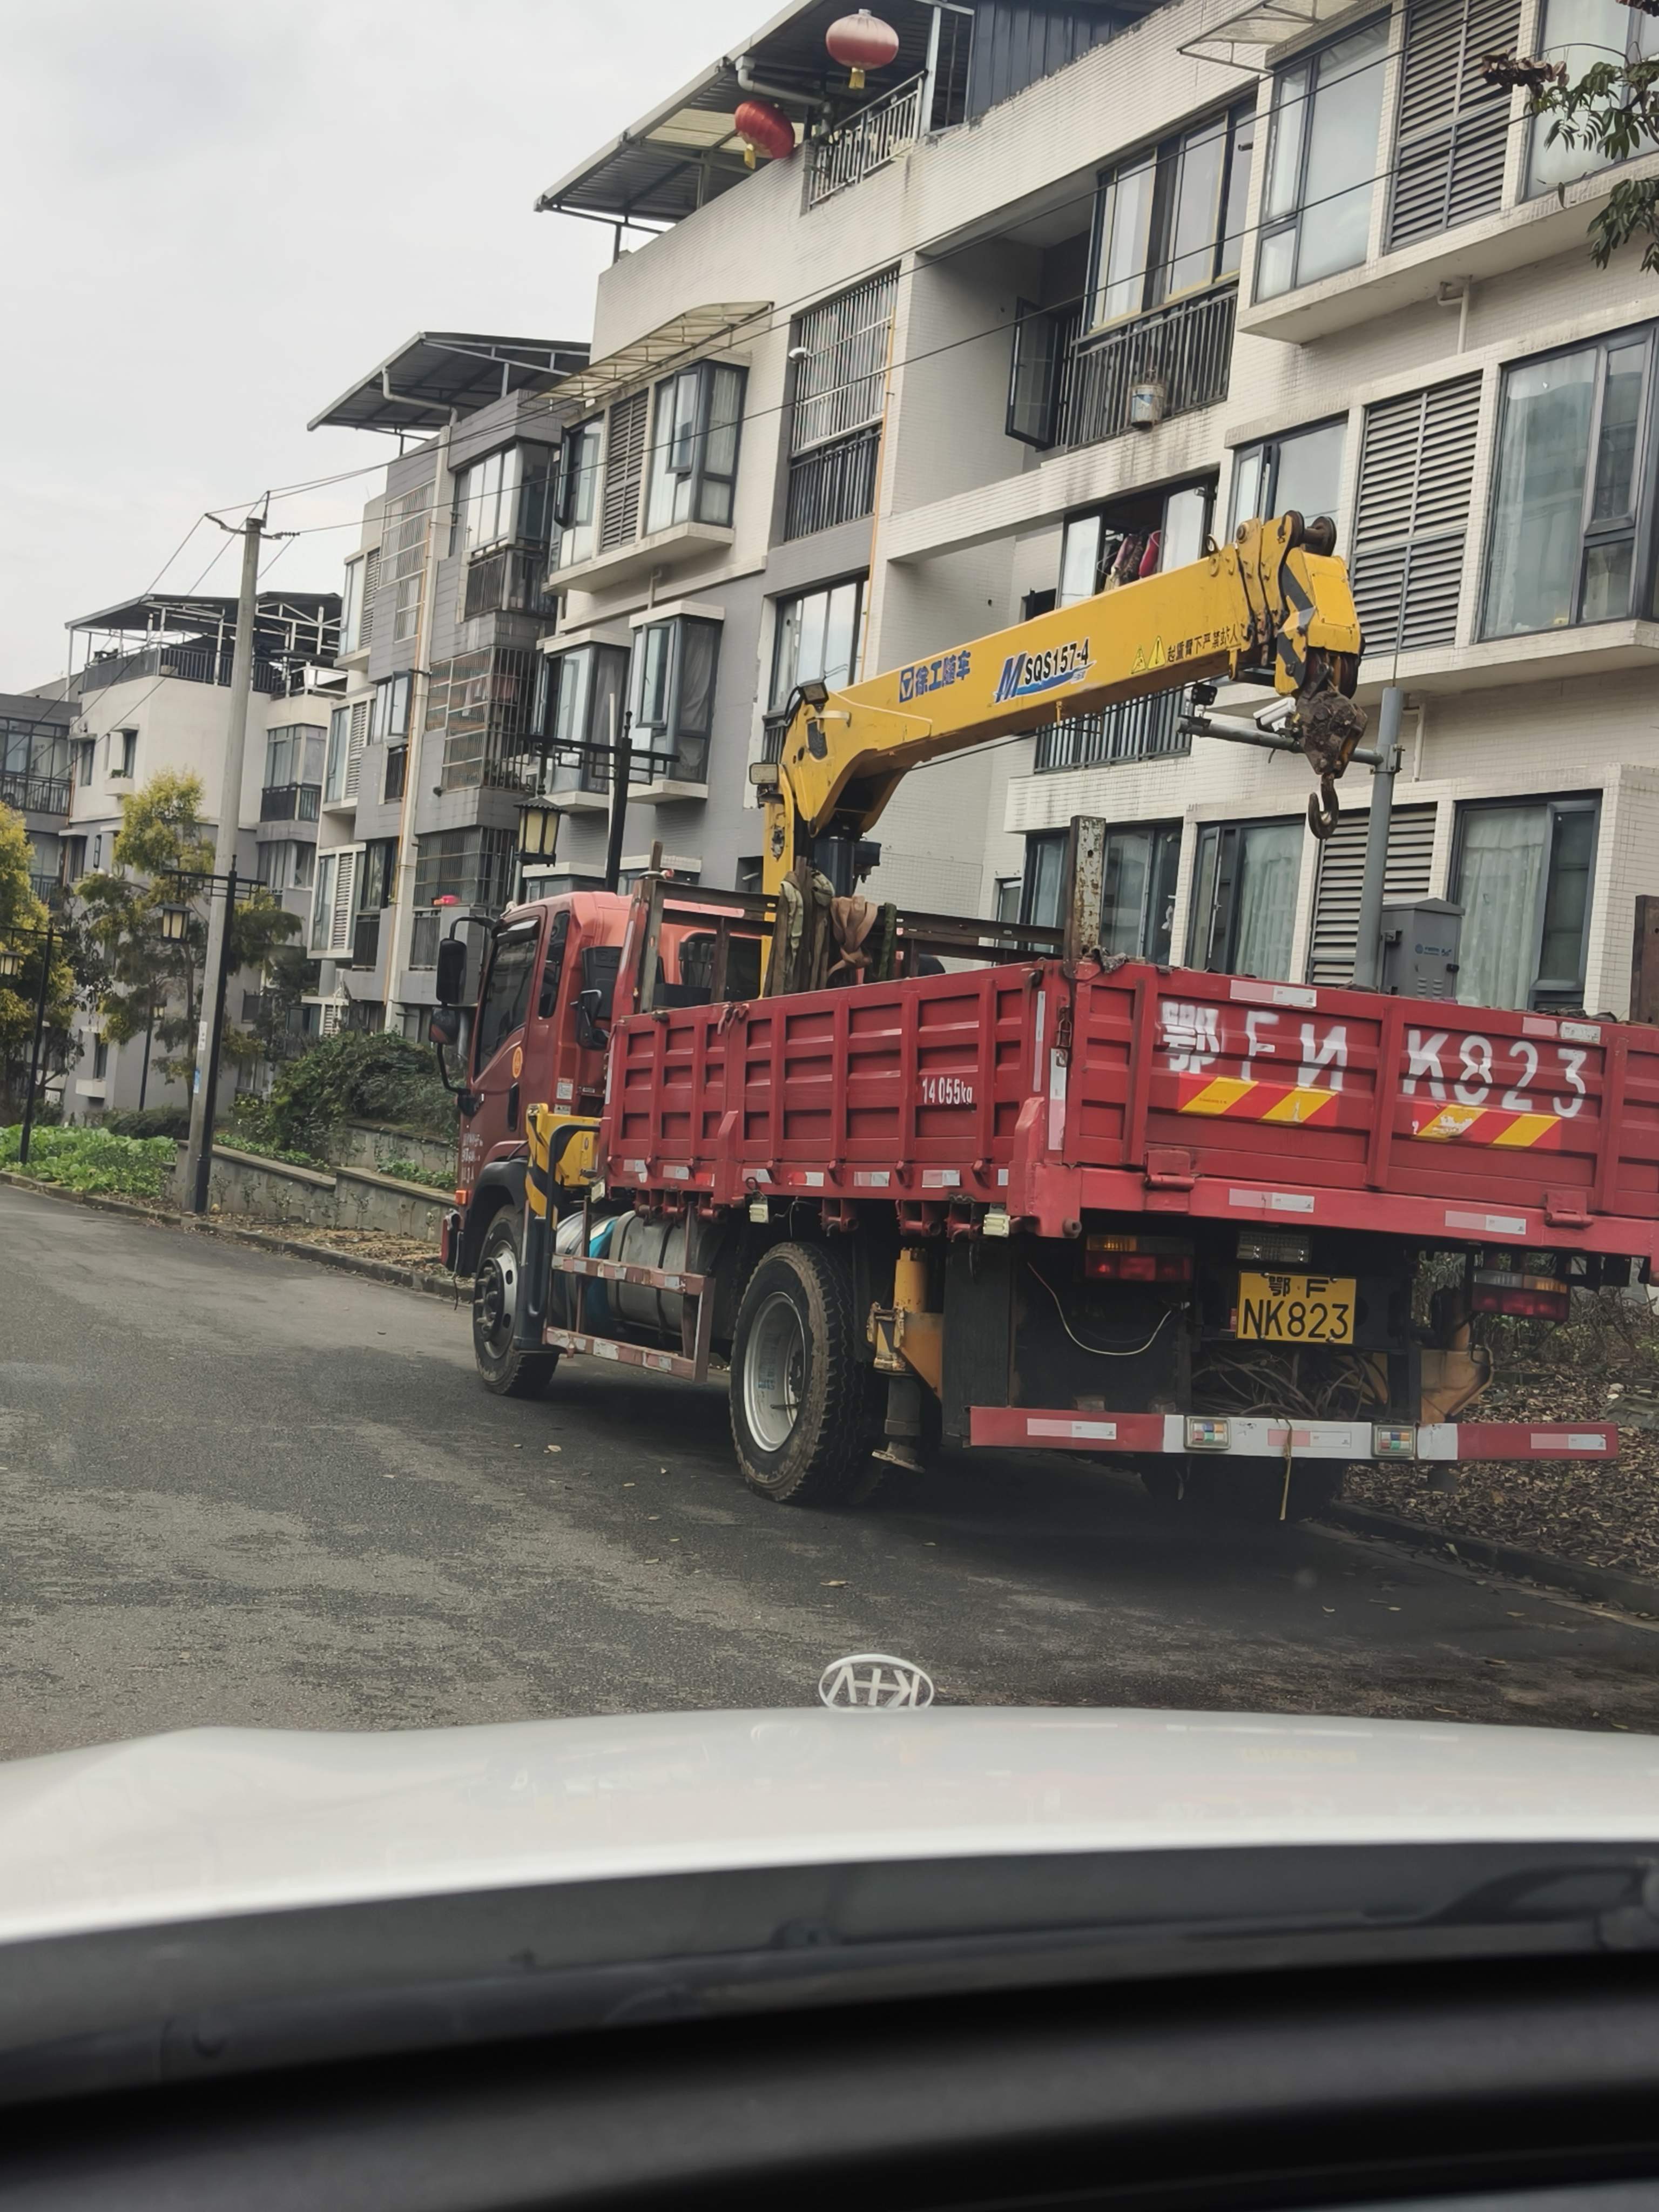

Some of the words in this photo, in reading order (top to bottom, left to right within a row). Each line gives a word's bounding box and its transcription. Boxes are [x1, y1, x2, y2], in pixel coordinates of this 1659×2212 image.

[1168, 624, 1239, 662] 起重臂下严禁站人
[915, 650, 970, 697] 徐工随车
[1243, 1298, 1348, 1339] NK823
